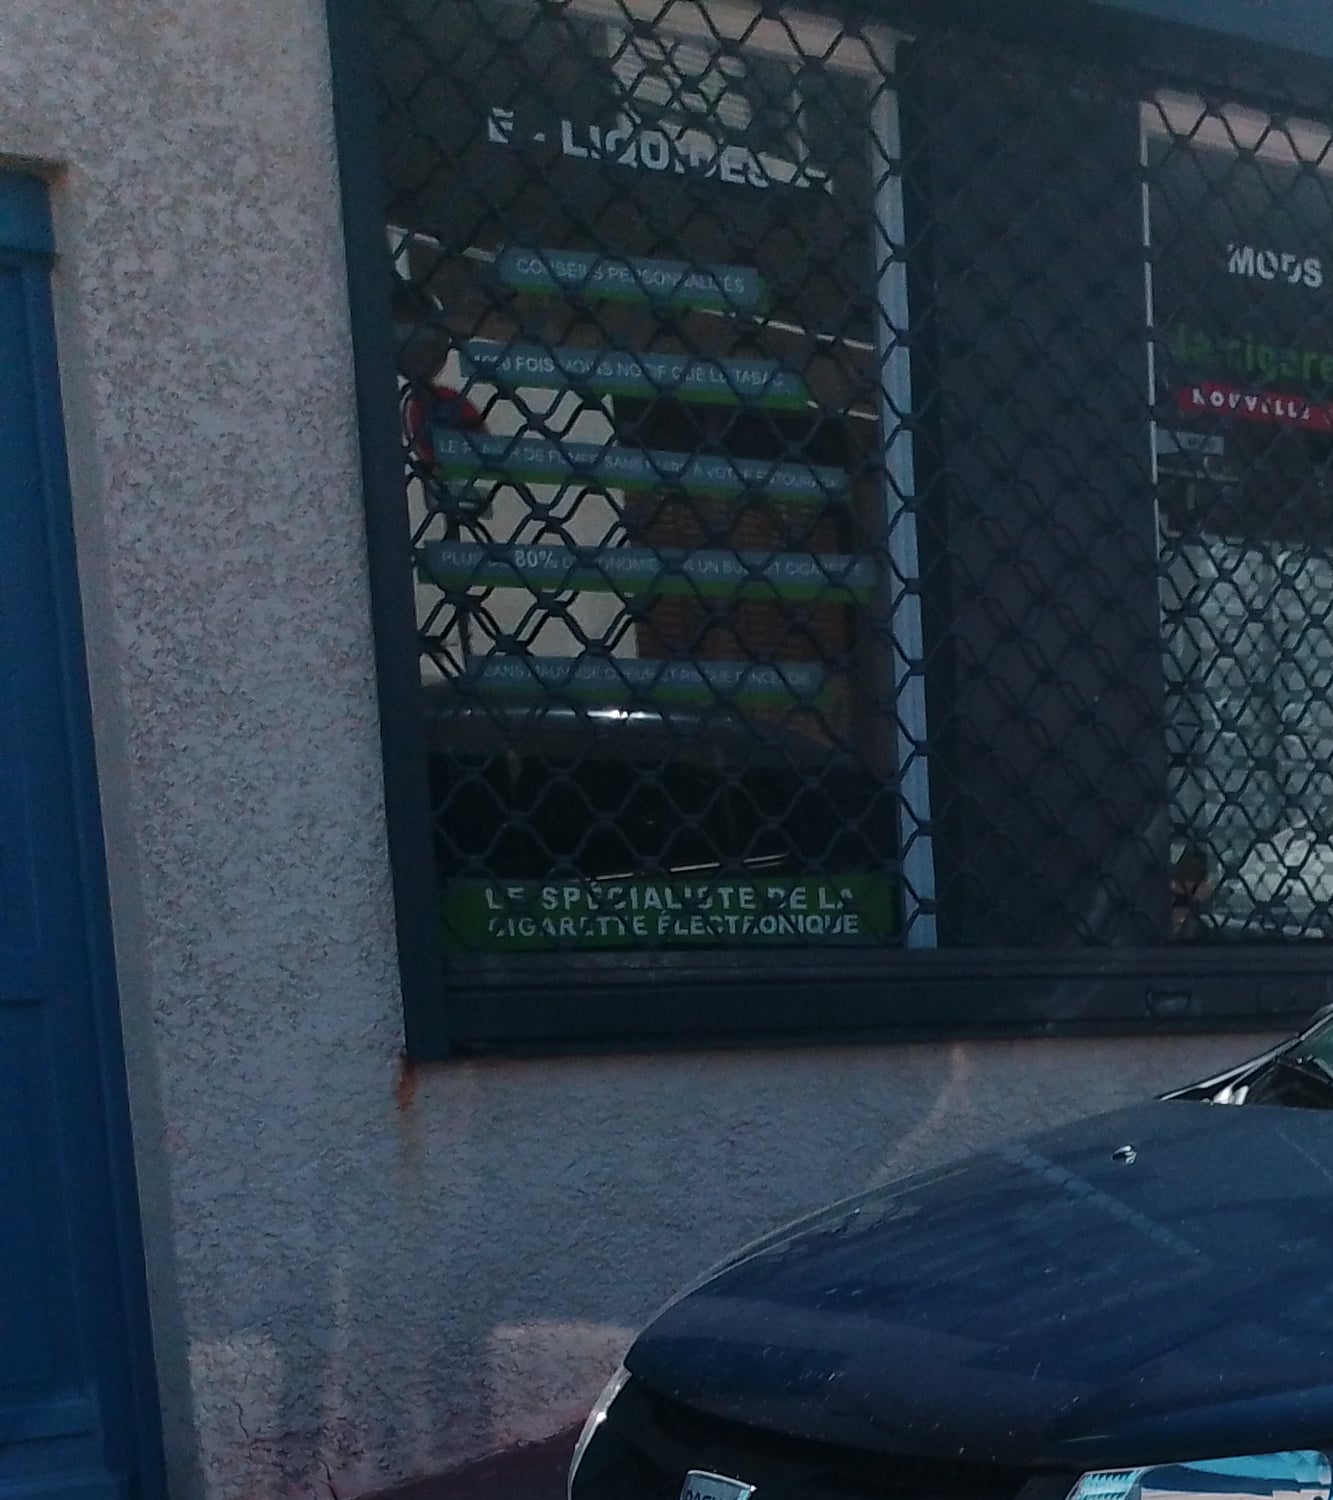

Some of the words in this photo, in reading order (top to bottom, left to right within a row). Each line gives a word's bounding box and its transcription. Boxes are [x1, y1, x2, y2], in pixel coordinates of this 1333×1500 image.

[515, 356, 556, 373] FOIS
[617, 362, 667, 379] NOIF
[514, 549, 559, 569] 80%
[487, 915, 648, 938] CIGARETTE
[657, 909, 859, 936] ÉLECTRONIQUE
